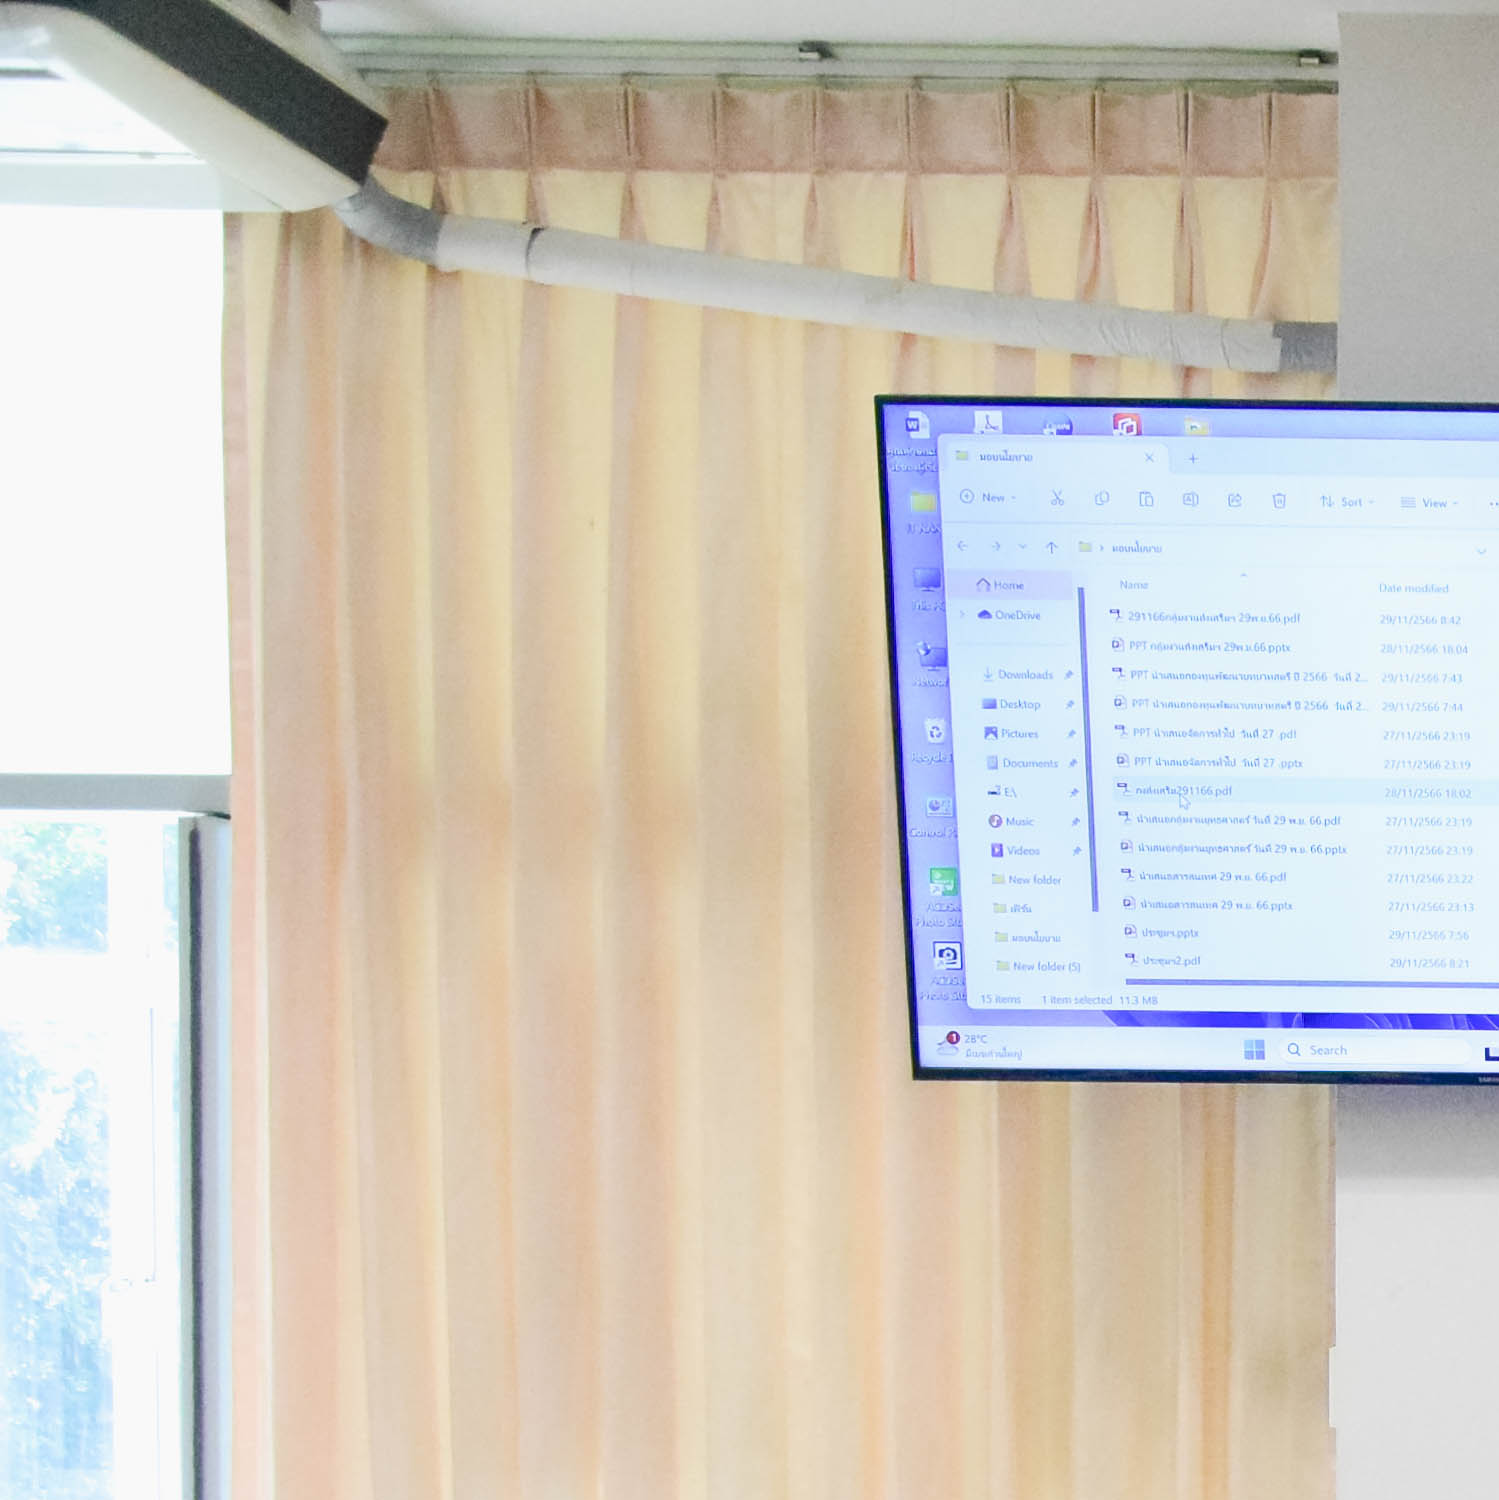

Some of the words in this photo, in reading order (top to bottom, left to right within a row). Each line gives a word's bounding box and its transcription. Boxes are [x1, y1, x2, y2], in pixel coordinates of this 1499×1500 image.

[982, 491, 1005, 503] New
[1341, 496, 1363, 508] Sort
[1422, 497, 1448, 509] View
[993, 580, 1025, 591] Home
[1119, 580, 1149, 591] Name
[1378, 582, 1402, 594] Date
[1404, 582, 1449, 594] modified
[995, 610, 1041, 621] OneDrive
[1129, 640, 1147, 650] PPT
[998, 669, 1053, 681] Downloads
[1131, 669, 1149, 680] PPT
[1000, 699, 1041, 712] Desktop
[1132, 698, 1149, 709] PPT
[1001, 728, 1039, 739] Pictures
[1133, 727, 1151, 738] PPT
[1002, 758, 1059, 769] Documents
[1134, 757, 1152, 767] PPT
[1006, 816, 1034, 826] Music
[1273, 815, 1286, 825] 29
[1310, 815, 1341, 827] 66.pdf
[1007, 845, 1041, 856] Videos
[1275, 844, 1287, 854] 29
[1310, 844, 1347, 857] 66.pptx
[1009, 875, 1031, 885] New
[1033, 874, 1062, 885] folder
[1220, 872, 1232, 882] 29
[1255, 871, 1287, 883] 66.pdf
[1220, 900, 1233, 910] 29
[1256, 900, 1293, 912] 66.pptx
[1013, 962, 1034, 971] New
[1037, 961, 1065, 971] folder
[979, 995, 991, 1005] 15
[993, 995, 1021, 1005] items
[1050, 994, 1071, 1005] item
[1073, 994, 1112, 1005] selected
[1142, 995, 1159, 1005] MB
[1310, 1044, 1348, 1056] Search
